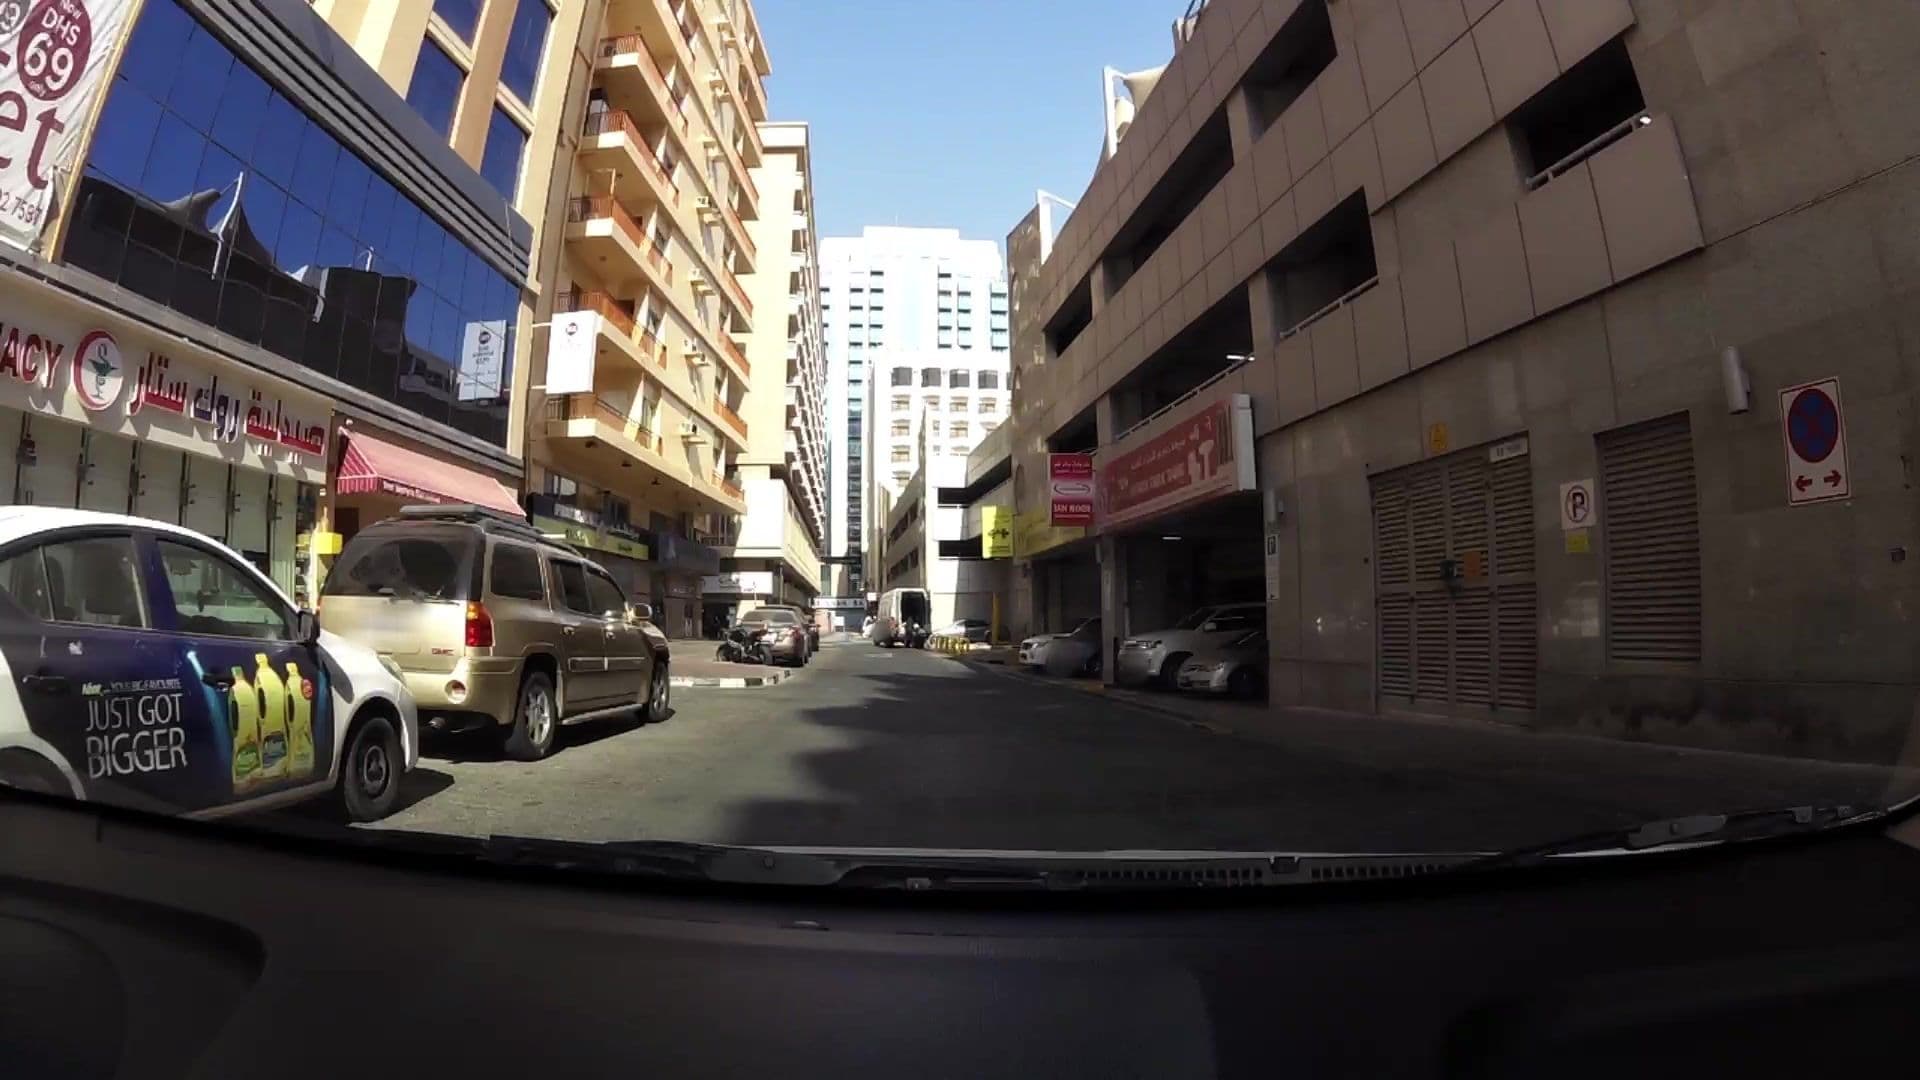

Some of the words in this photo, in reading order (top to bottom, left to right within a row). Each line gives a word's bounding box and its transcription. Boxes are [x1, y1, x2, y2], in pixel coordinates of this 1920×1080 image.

[41, 6, 81, 46] DHS
[24, 31, 74, 91] 69
[0, 322, 64, 389] ACY
[127, 350, 188, 418] ستار
[244, 386, 325, 466] صيدلية
[86, 697, 133, 731] JUST
[138, 693, 183, 725] GOT
[86, 727, 188, 778] BIGGER
